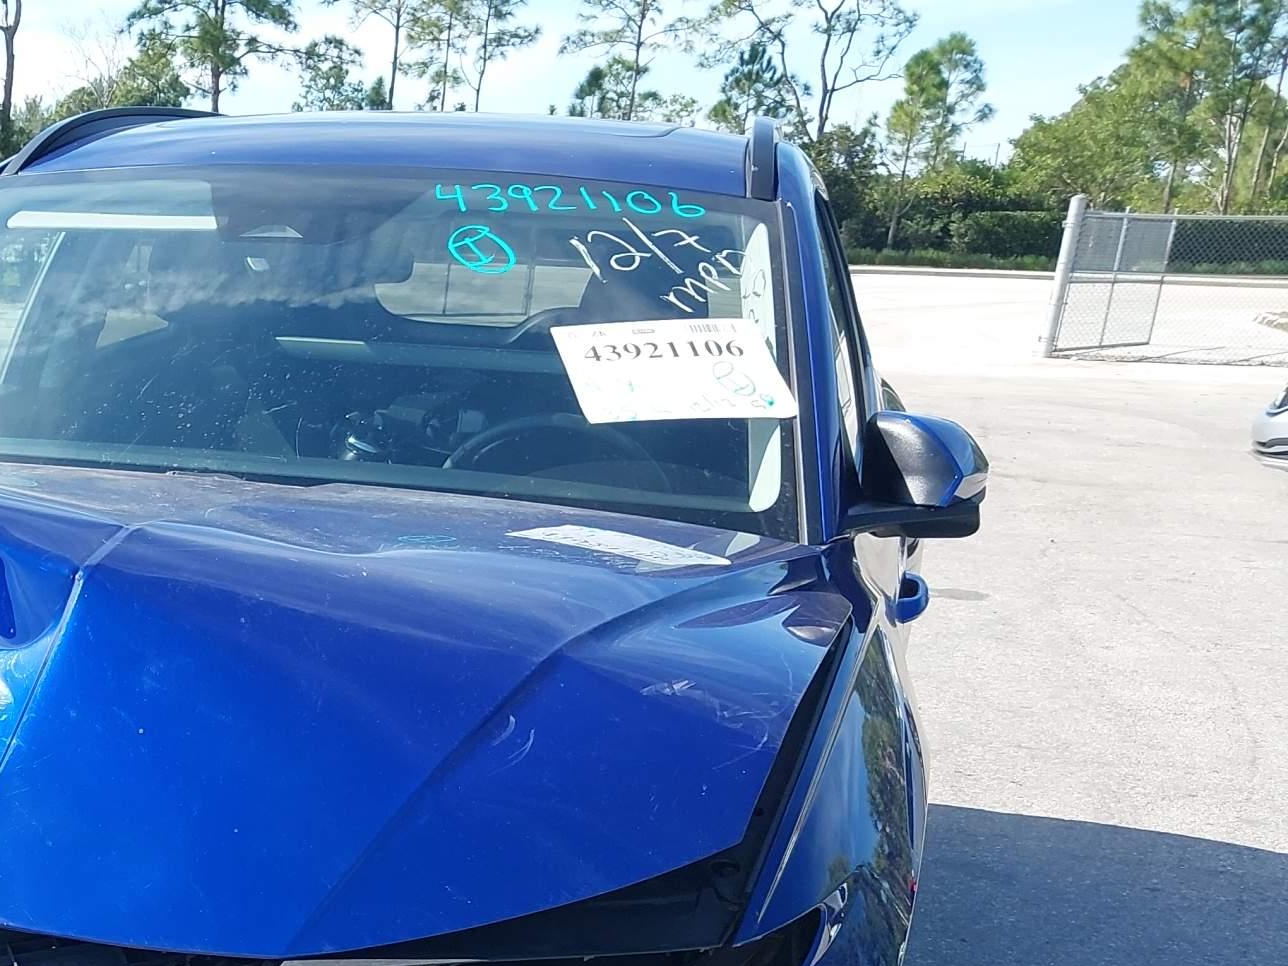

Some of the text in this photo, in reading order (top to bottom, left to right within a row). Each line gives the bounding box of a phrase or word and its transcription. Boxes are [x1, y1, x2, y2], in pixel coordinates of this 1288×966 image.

[436, 184, 706, 218] 43921106
[569, 217, 711, 284] 12/7
[584, 339, 745, 362] 43921106
